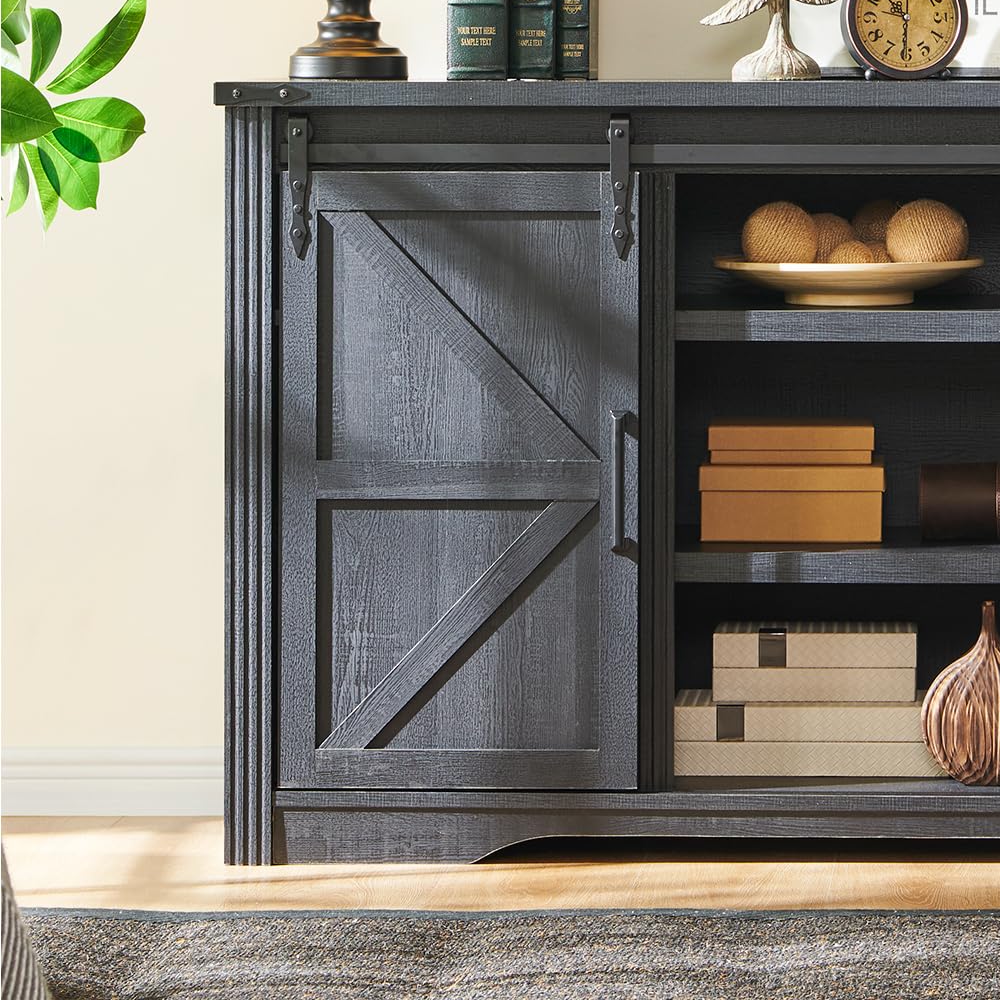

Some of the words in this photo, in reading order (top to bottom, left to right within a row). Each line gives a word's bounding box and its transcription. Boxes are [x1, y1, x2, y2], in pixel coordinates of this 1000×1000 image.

[863, 11, 877, 24] 9
[933, 11, 948, 24] 3
[470, 26, 482, 35] TEXT
[482, 26, 496, 35] HERE
[867, 28, 884, 42] 8
[930, 30, 944, 43] 4
[460, 38, 479, 46] SAMPLE
[479, 38, 492, 46] TEXT
[883, 40, 896, 55] 7
[917, 41, 930, 56] 5
[900, 48, 912, 61] 6
